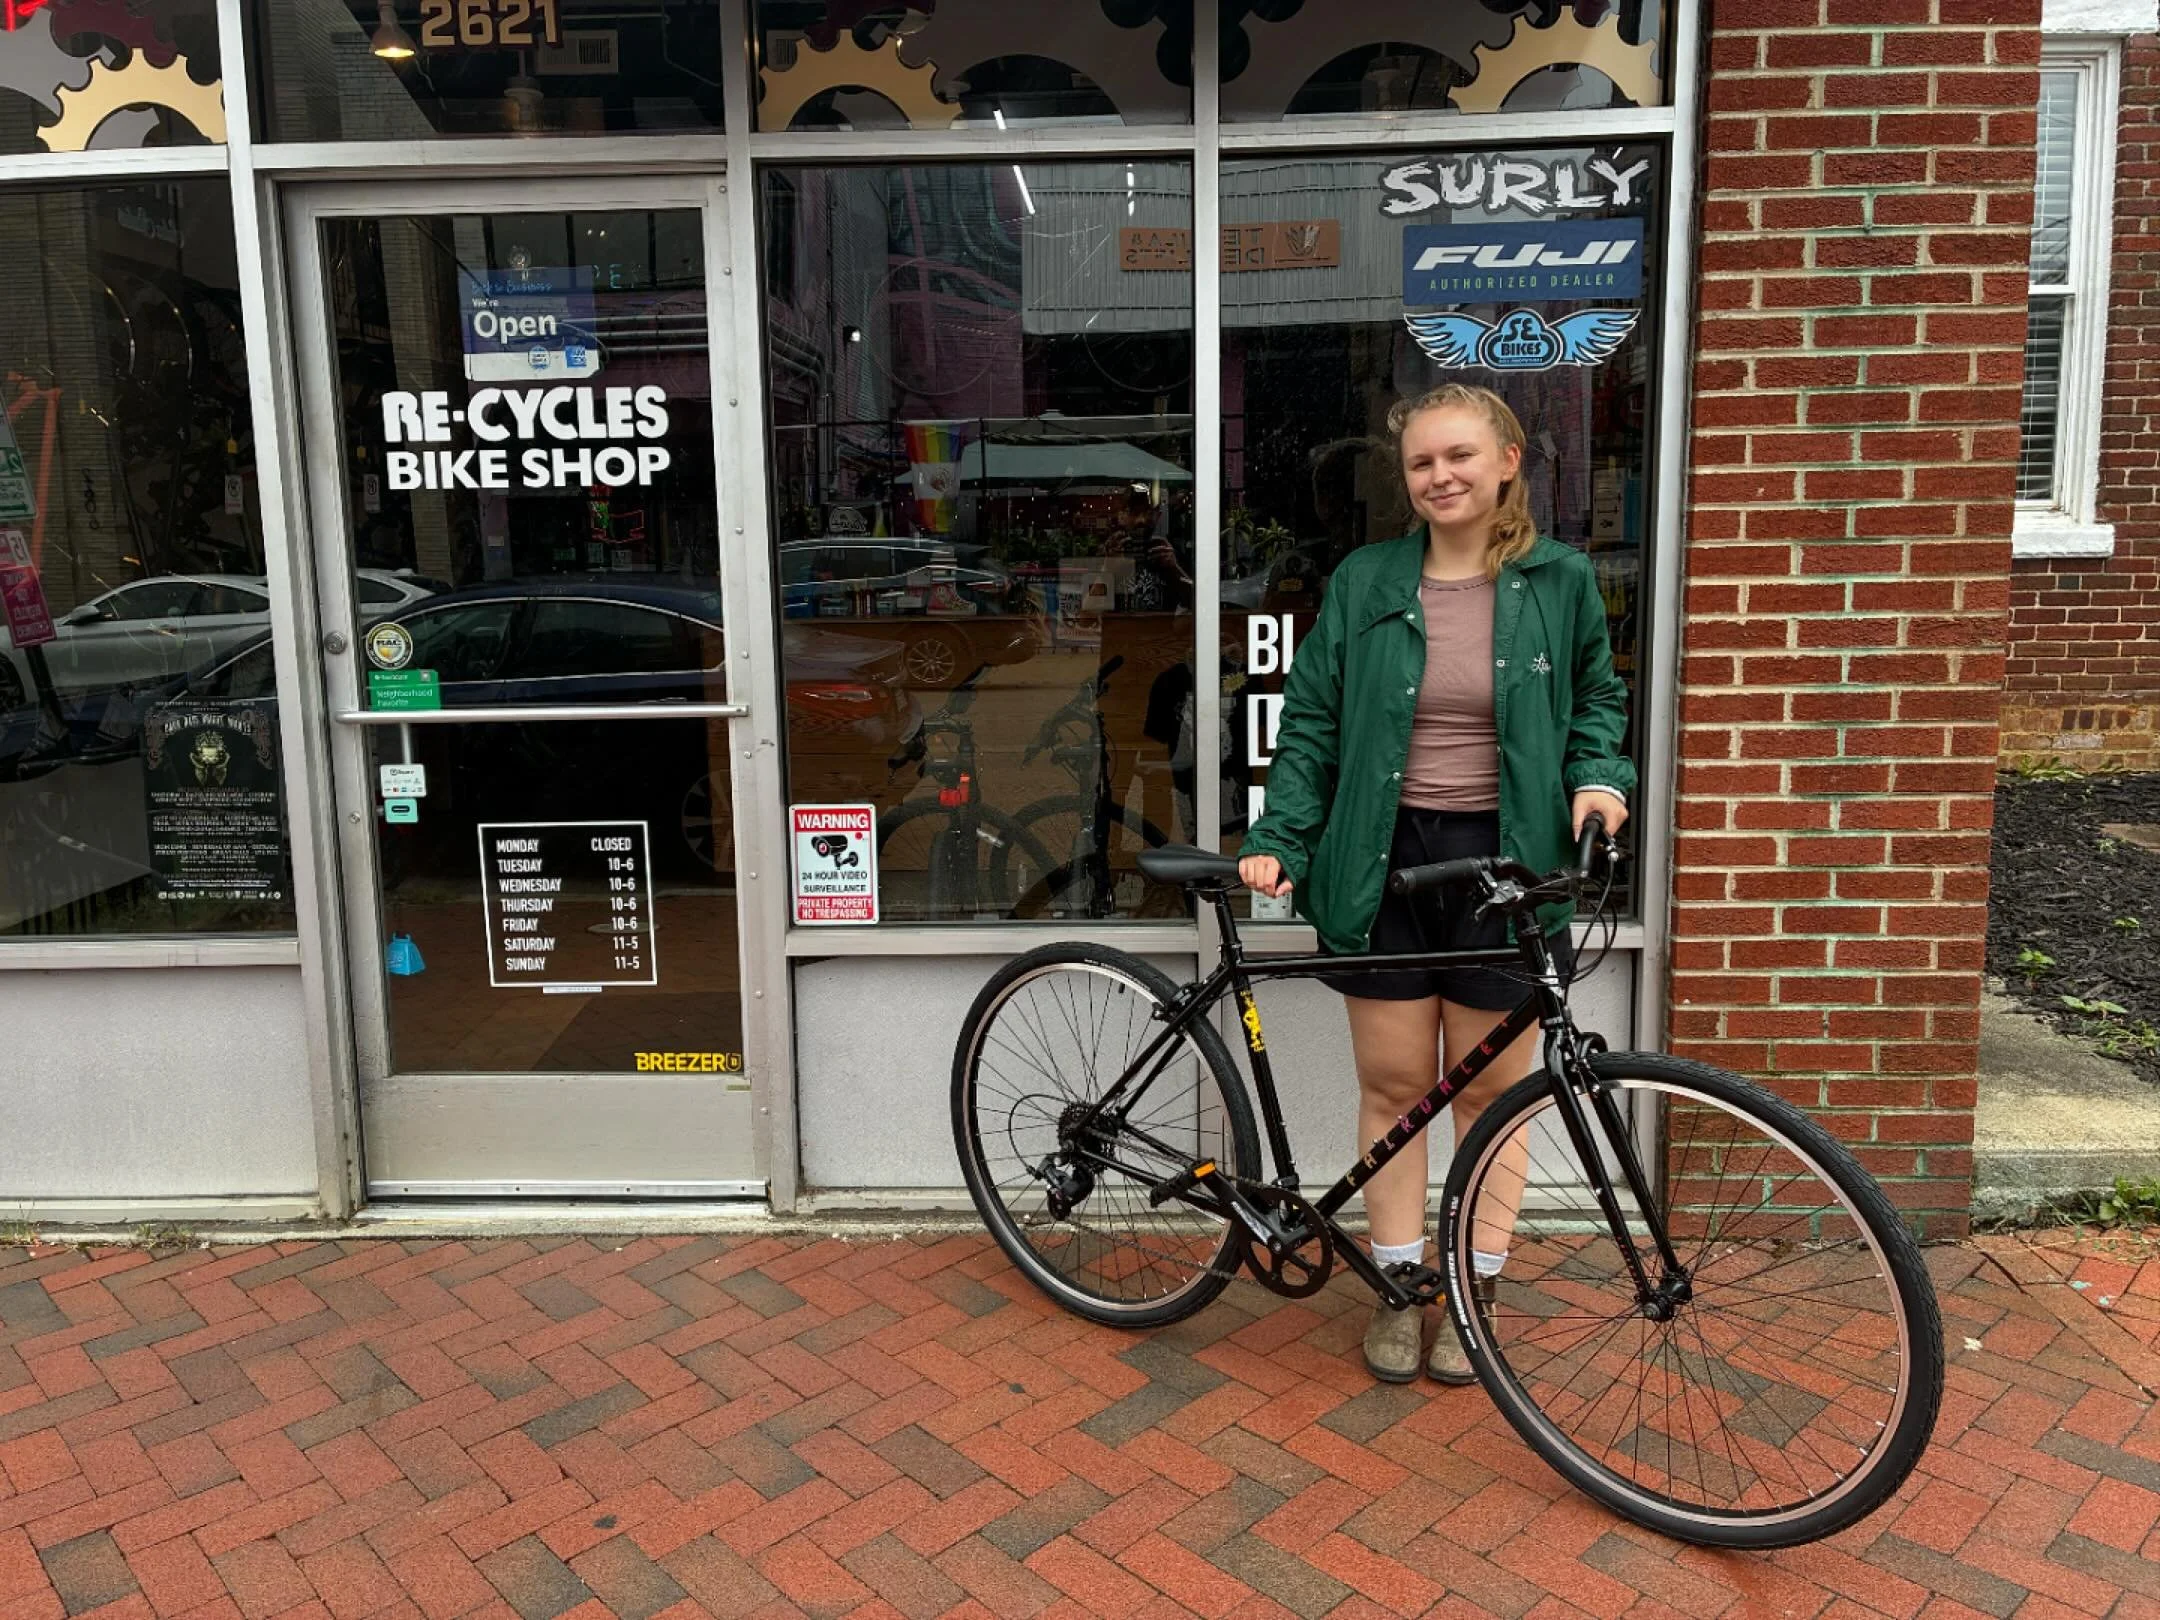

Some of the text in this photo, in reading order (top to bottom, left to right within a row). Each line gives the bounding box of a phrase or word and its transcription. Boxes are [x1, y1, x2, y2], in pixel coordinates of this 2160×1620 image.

[420, 0, 558, 46] 2621
[1382, 157, 1650, 215] SURLY
[1412, 239, 1637, 271] FUJI
[1429, 273, 1615, 290] AUTHORIZED DEALER
[473, 310, 558, 345] Open
[1502, 317, 1540, 342] SE
[1501, 342, 1542, 356] BIKES
[381, 385, 670, 443] RE-CYCLES
[386, 446, 671, 490] BIKE SHOP
[797, 814, 869, 829] WARNING
[496, 837, 632, 853] MONDAY CLOSED
[497, 857, 634, 873] TUESDAY 10-6
[801, 870, 868, 880] 24 HOUR VIDEO
[499, 877, 636, 892] WEDNESDAY 10-6
[803, 884, 867, 893] SURVEILLANCE
[500, 897, 637, 912] THURSDAY 10-6
[798, 898, 873, 908] PRIVATE PROPERTY
[802, 908, 868, 919] NO TRESPASSING
[502, 917, 637, 932] FRIDAY 10-6
[504, 936, 639, 951] SATURDAY 11-5
[505, 956, 640, 971] SUNDAY 11-5
[634, 1052, 727, 1072] BREEZER
